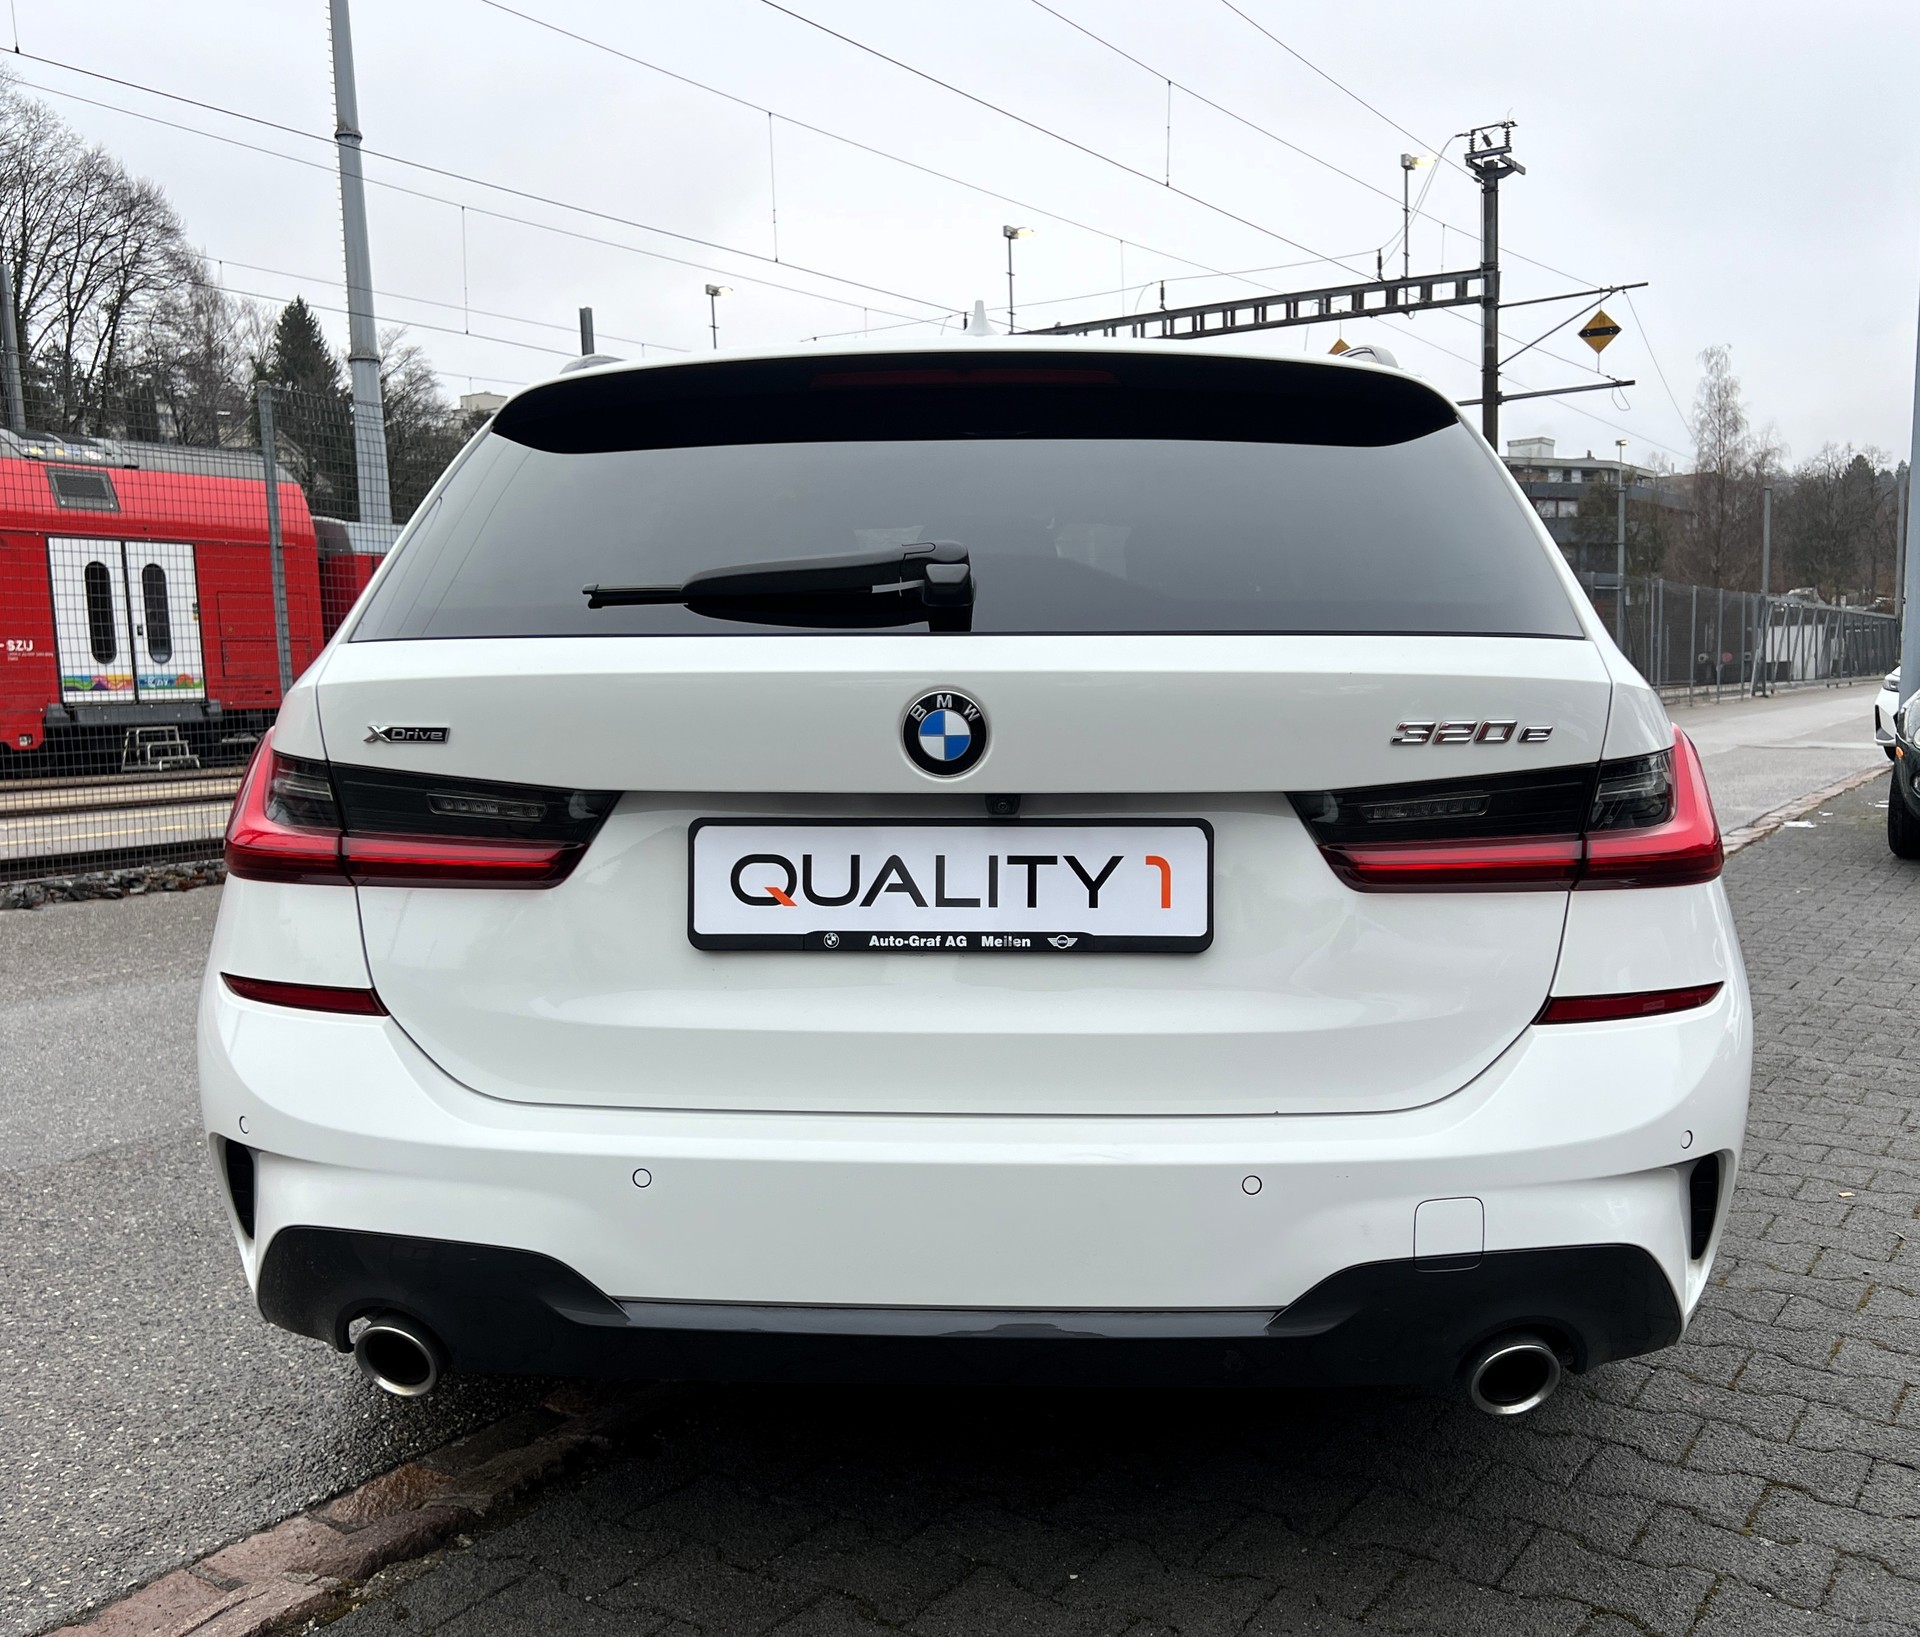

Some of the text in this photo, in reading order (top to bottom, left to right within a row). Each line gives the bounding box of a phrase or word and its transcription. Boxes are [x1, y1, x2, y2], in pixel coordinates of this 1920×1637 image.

[910, 694, 981, 722] BMW
[730, 853, 1172, 909] QUALITY 1
[869, 935, 1031, 947] Auto-Graf AG Meilen
